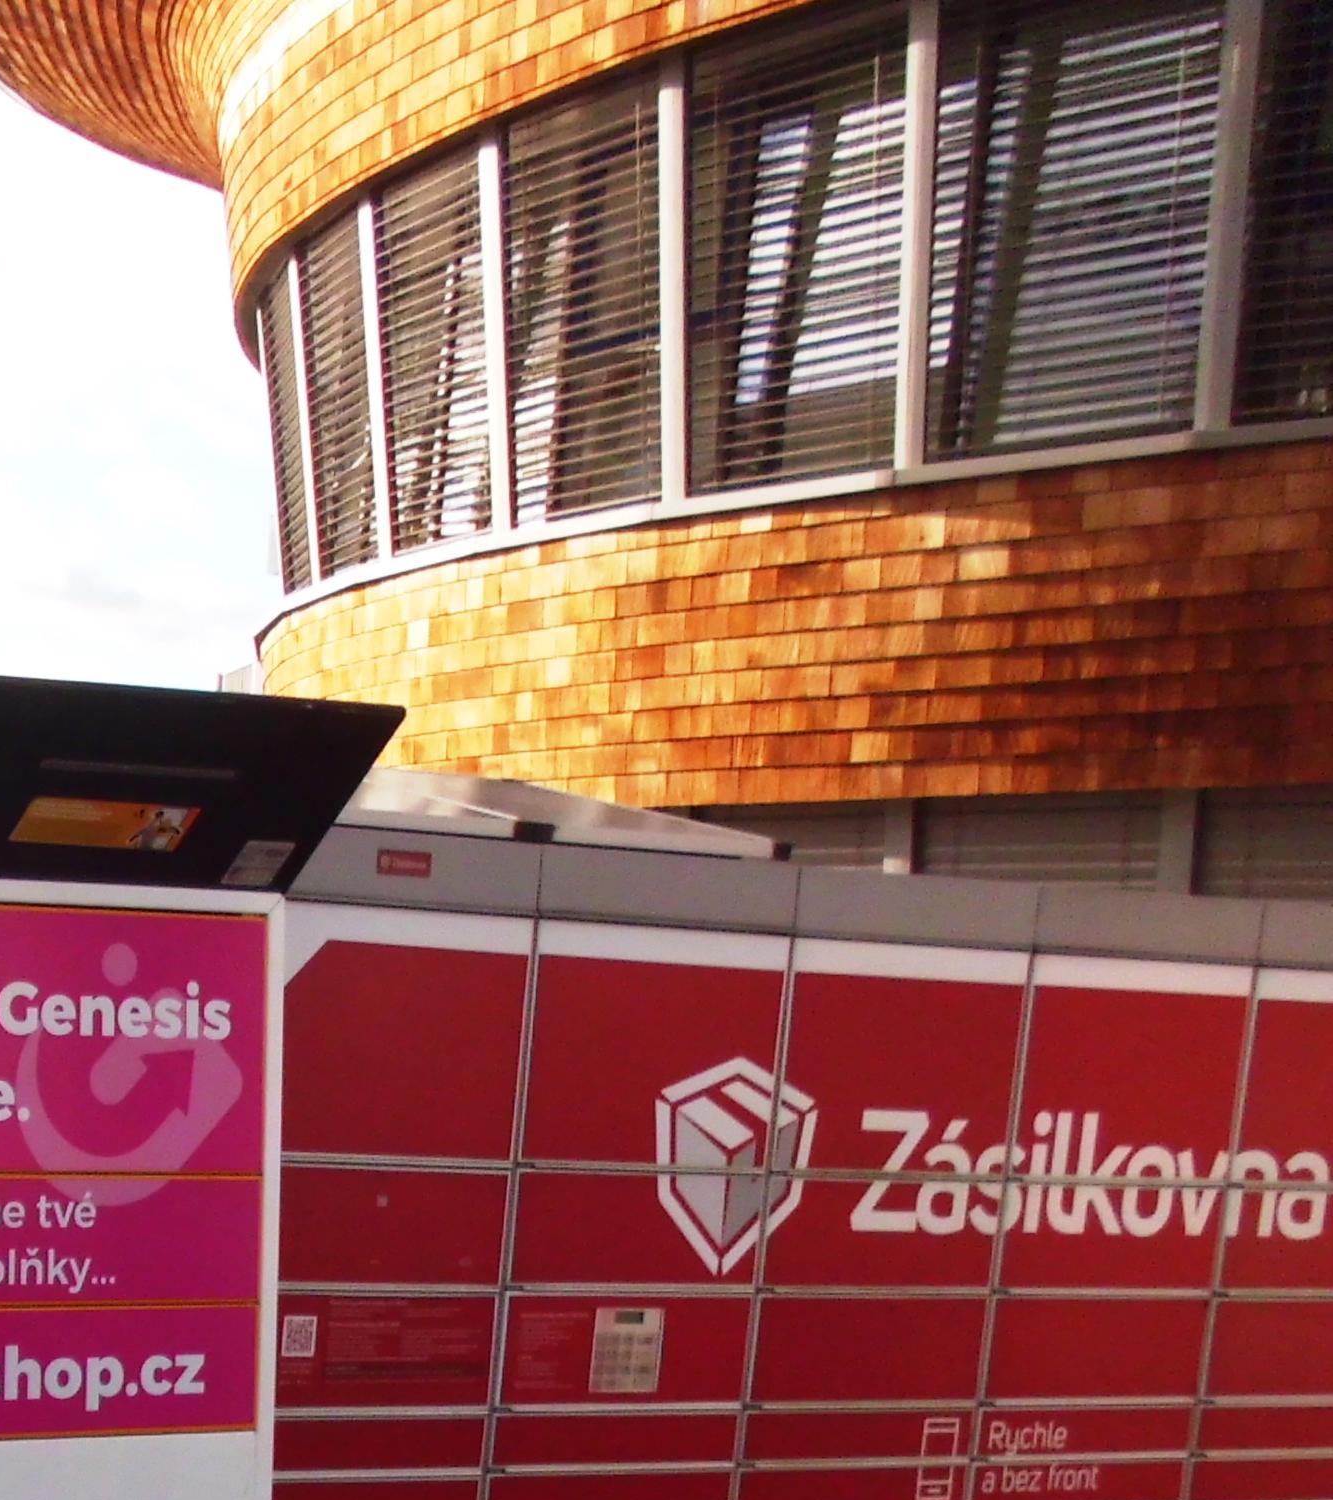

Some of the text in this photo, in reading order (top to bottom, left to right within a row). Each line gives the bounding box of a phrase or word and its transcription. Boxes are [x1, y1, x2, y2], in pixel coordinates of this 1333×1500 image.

[850, 1109, 1330, 1241] Zásilkovna
[36, 1191, 98, 1230] tvé
[987, 1419, 1068, 1456] Rychle
[982, 1463, 1099, 1493] a bez front
